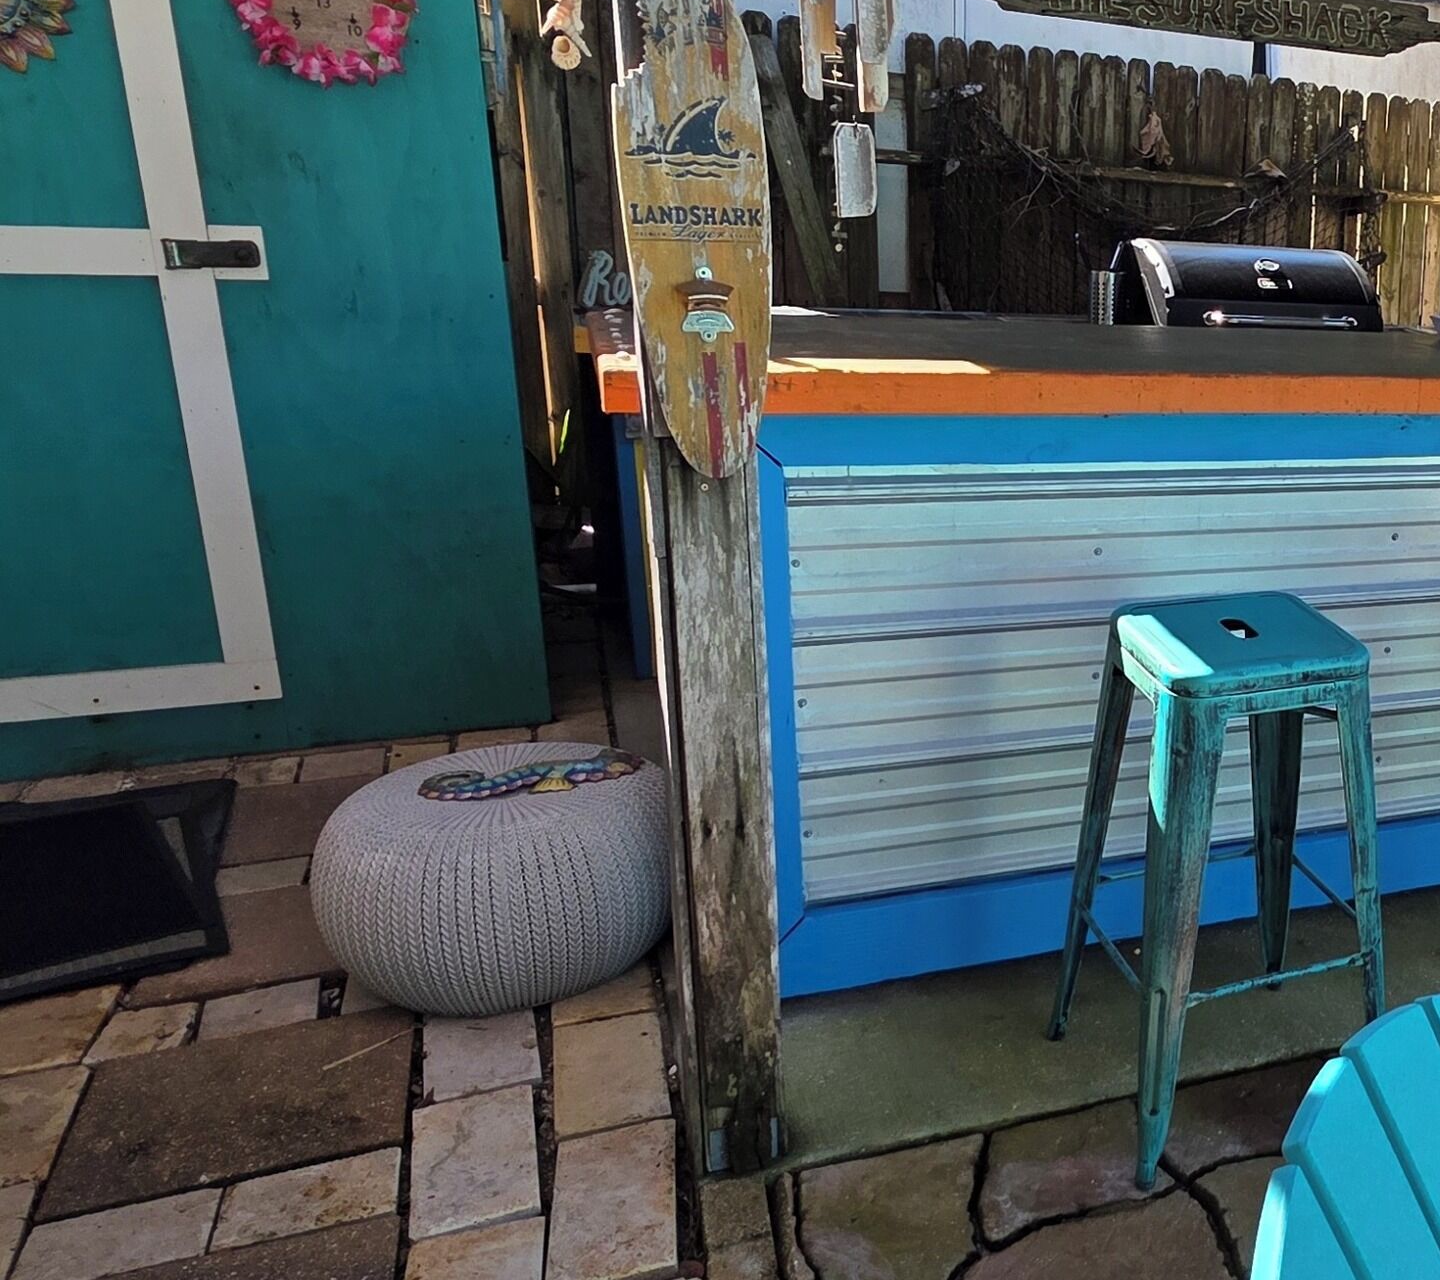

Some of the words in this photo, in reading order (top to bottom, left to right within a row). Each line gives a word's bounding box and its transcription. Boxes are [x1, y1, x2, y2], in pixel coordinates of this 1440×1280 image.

[293, 19, 301, 31] 9
[348, 25, 363, 37] 10
[629, 203, 762, 227] LANDSHARK
[671, 224, 727, 244] Lager
